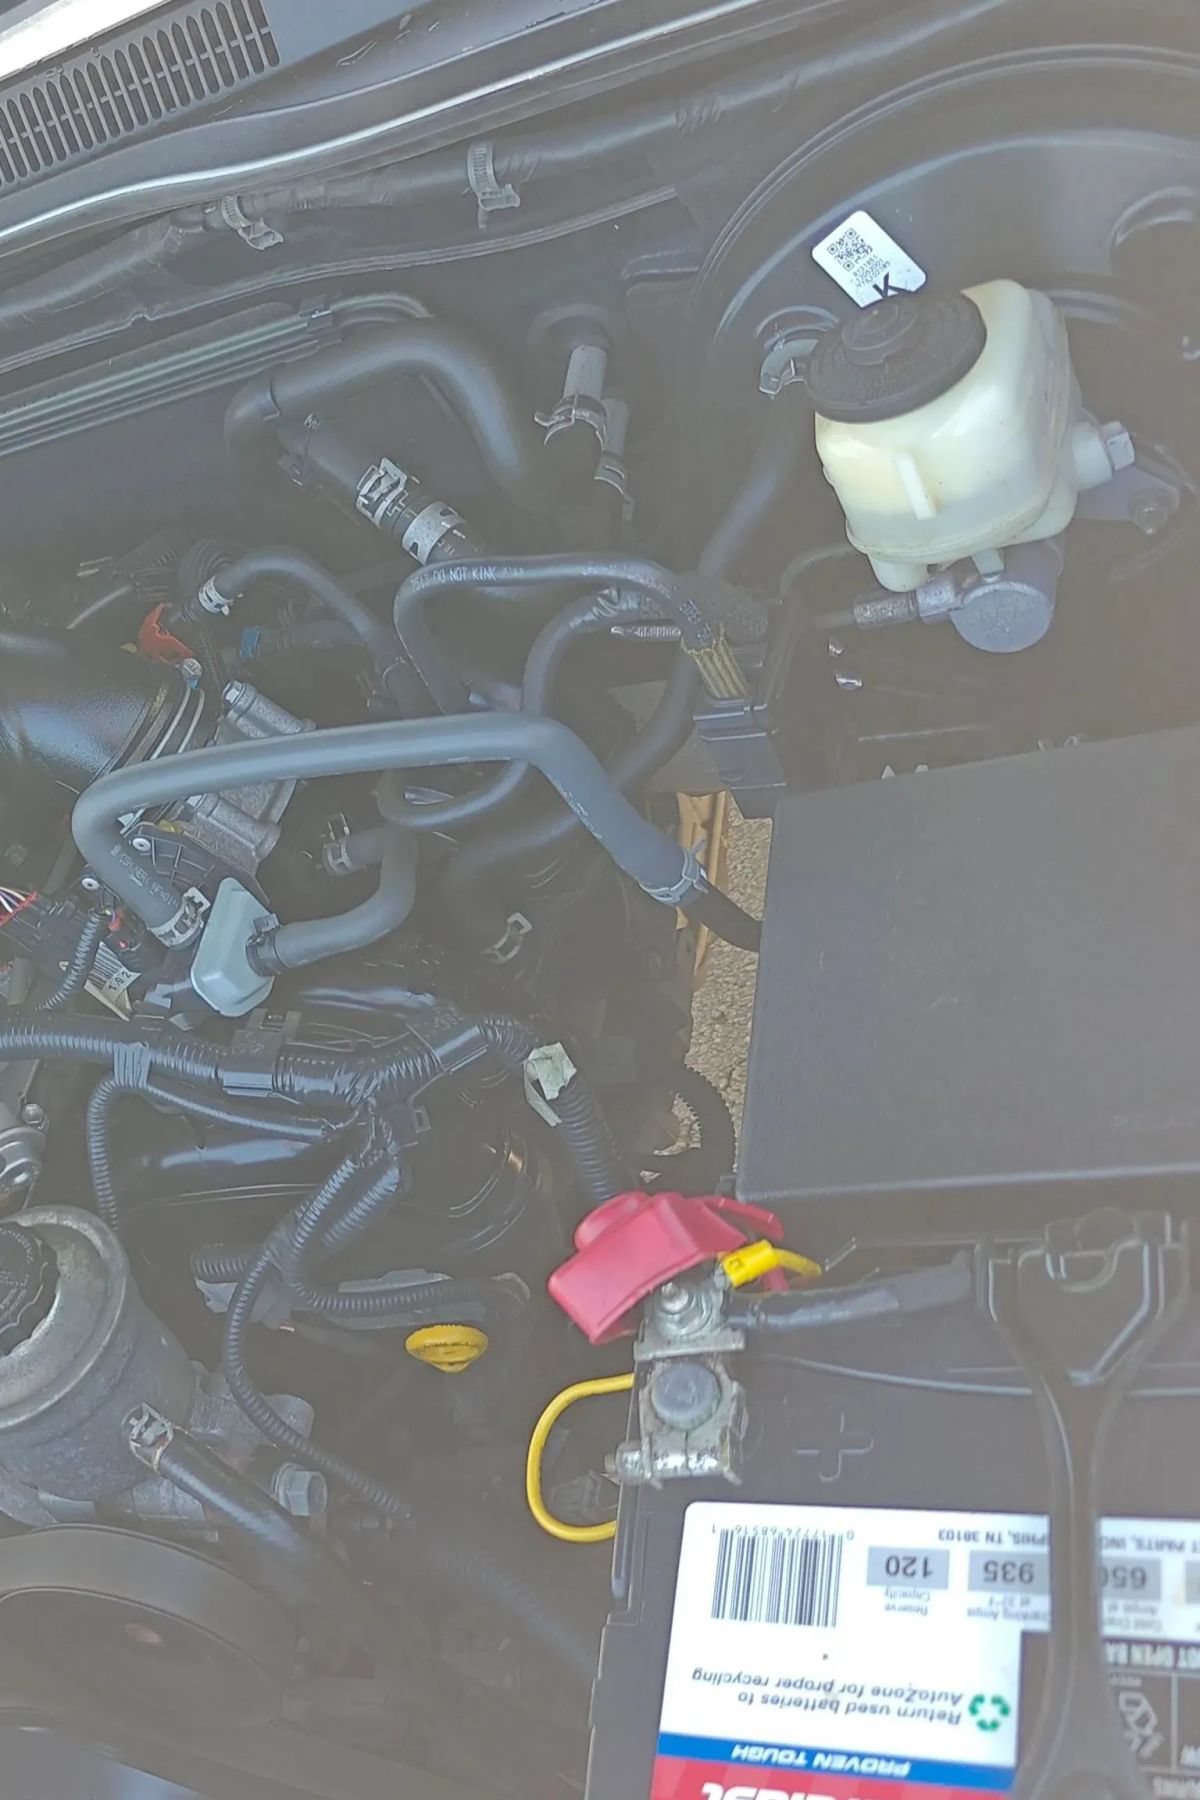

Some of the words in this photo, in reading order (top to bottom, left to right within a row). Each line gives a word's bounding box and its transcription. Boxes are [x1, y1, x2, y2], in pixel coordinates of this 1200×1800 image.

[872, 272, 908, 299] K
[449, 566, 467, 581] NOT
[472, 566, 497, 580] KINK
[938, 1528, 981, 1542] 38103
[885, 1555, 933, 1578] 120
[983, 1560, 1035, 1585] 935
[691, 1667, 770, 1687] recycling
[776, 1676, 835, 1694] proper
[737, 1691, 755, 1704] to
[840, 1682, 864, 1699] for
[871, 1685, 964, 1706] AutoZone
[760, 1694, 840, 1715] batteries
[845, 1699, 890, 1717] used
[896, 1704, 962, 1726] Return
[731, 1744, 809, 1767] TOUGH
[813, 1752, 912, 1778] PROVEN
